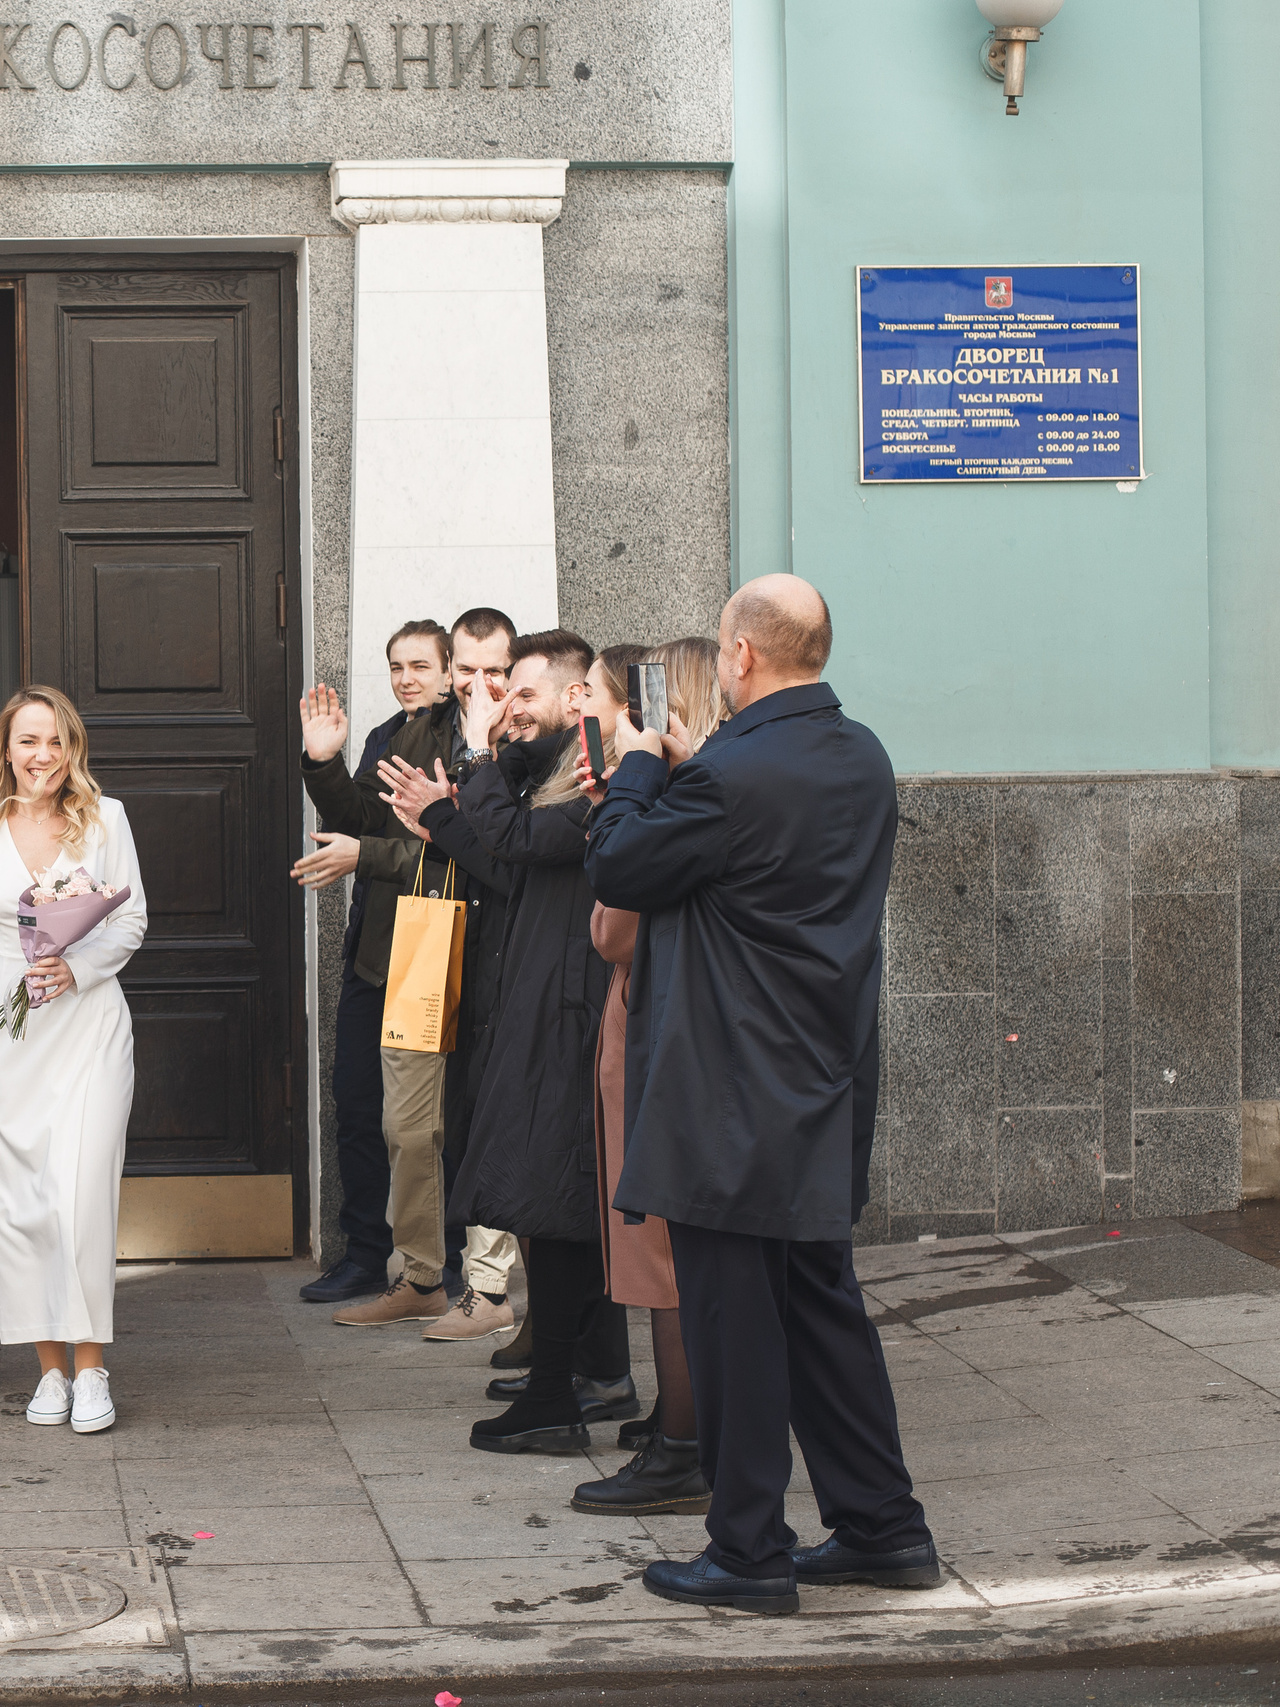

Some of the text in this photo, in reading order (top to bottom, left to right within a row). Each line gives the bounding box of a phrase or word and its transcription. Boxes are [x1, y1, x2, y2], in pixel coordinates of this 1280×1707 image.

[944, 313, 1055, 323] Правительство Москвы
[878, 322, 935, 332] Управление
[1002, 322, 1069, 331] гражданского
[1071, 322, 1120, 330] состояния
[963, 331, 1036, 340] города Москвы
[955, 348, 1045, 367] ДВОРЕЦ
[880, 368, 1119, 385] БРАКОСОЧЕТАНИЯ №1
[958, 393, 1044, 403] ЧАСЫ РАБОТЫ
[881, 408, 1014, 418] ПОНЕДЕЛЬНИК, ВТОРНИК,
[1045, 413, 1074, 422] 09.00
[1076, 415, 1089, 423] до
[1092, 413, 1120, 422] 18.00
[881, 419, 1020, 429] СРЕДА, ЧЕТВЕРГ, ПЯТНИЦА
[881, 432, 929, 441] СУББОТА
[1045, 431, 1074, 439] 09.00
[1076, 432, 1089, 441] до
[1091, 431, 1120, 439] 24.00
[882, 444, 957, 453] ВОСКРЕСЕНЬЕ
[1046, 444, 1075, 452] 00.00
[1076, 445, 1089, 454] до
[1092, 443, 1120, 452] 18.00
[930, 458, 1074, 466] ПЕРВЫЙ ВТОРНИК КАЖДОГО МЕСЯЦА
[956, 466, 1047, 476] САНИТАРНЫЙ ДЕНЬ
